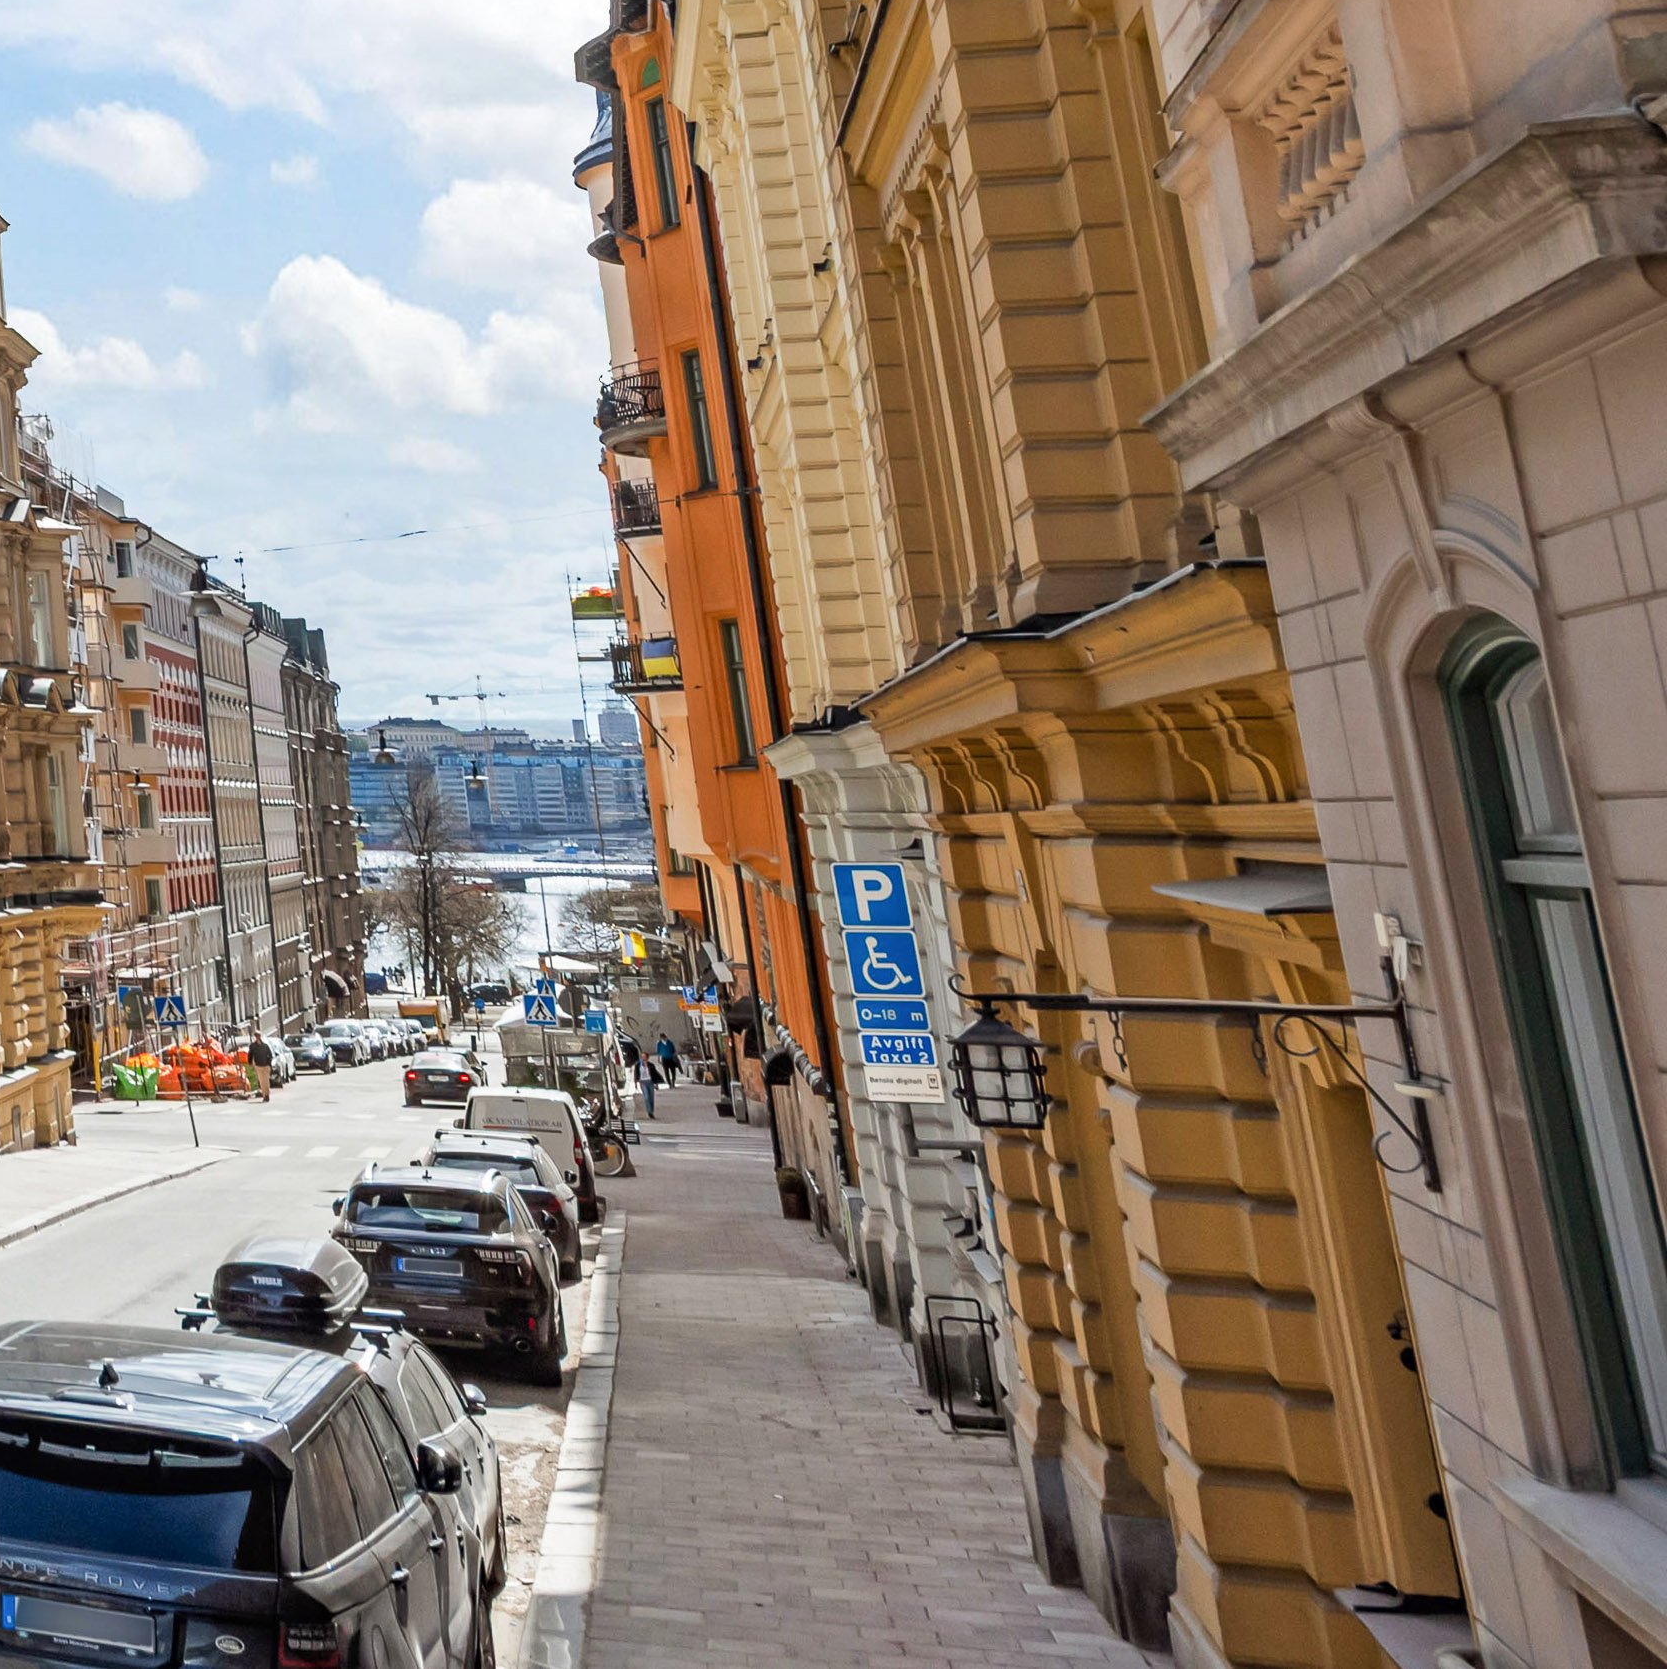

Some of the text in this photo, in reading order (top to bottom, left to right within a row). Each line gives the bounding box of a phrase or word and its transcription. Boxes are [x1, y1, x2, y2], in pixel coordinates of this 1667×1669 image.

[851, 870, 893, 921] P
[910, 1012, 924, 1022] m
[871, 1036, 924, 1052] Avgift
[869, 1050, 930, 1064] Taxa 2
[84, 1571, 197, 1598] ROVER
